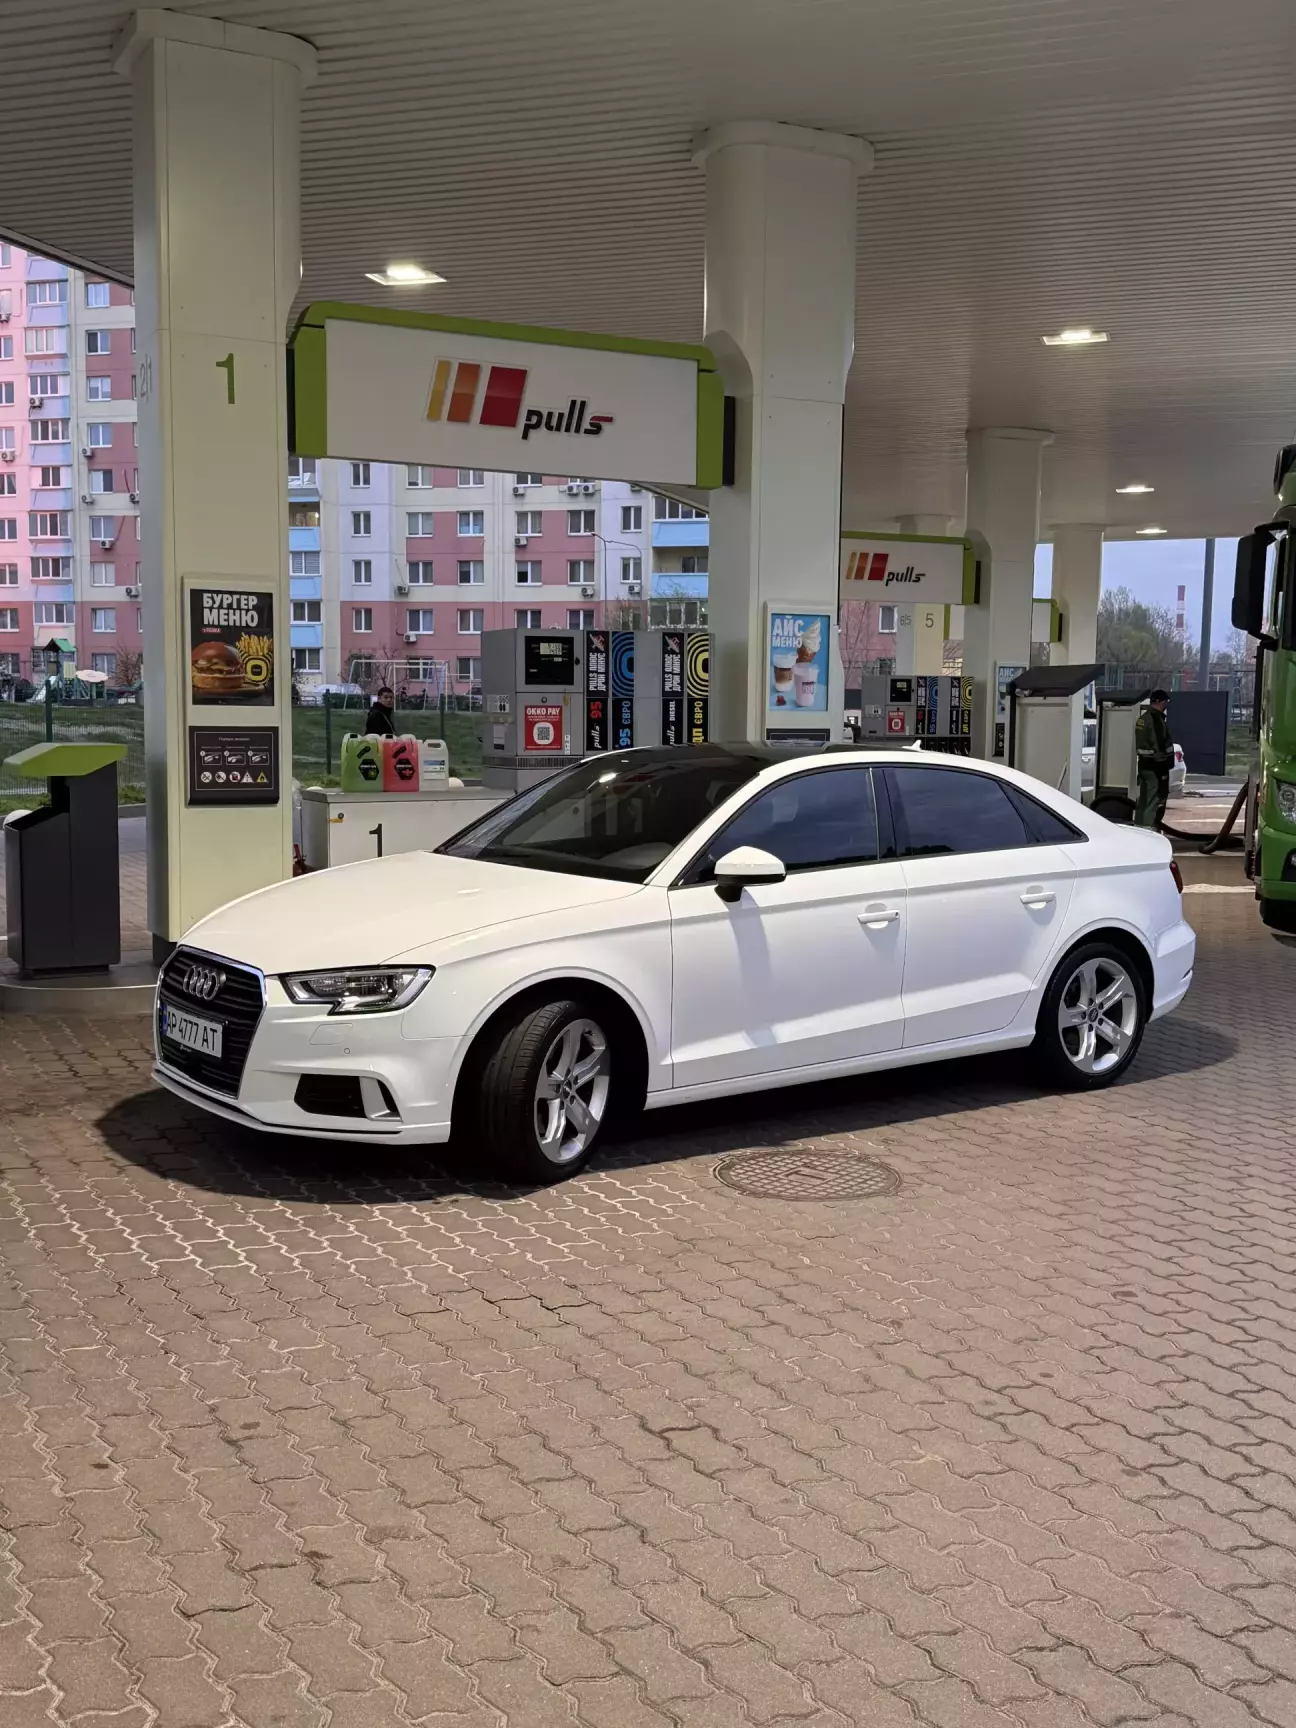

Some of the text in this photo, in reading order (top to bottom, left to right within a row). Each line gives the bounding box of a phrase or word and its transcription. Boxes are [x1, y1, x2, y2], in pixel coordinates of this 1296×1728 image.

[215, 352, 236, 405] 1
[521, 399, 614, 441] pulls
[884, 566, 926, 587] pulls
[202, 592, 258, 609] БУРГЕР
[203, 608, 259, 627] МЕНЮ
[772, 615, 804, 637] АЙС
[924, 612, 934, 629] 5
[772, 636, 803, 648] МЕНЮ
[589, 672, 598, 691] PULLS
[597, 653, 607, 692] ДРОН МІНУС
[664, 673, 673, 692] PULLS
[672, 654, 682, 692] ДРОН МІНУС
[527, 707, 561, 716] OKKO PAY
[590, 701, 602, 749] pulls 95
[620, 701, 631, 746] 95 ЄВРО
[692, 701, 704, 744] ДП ЄВРО
[369, 823, 382, 857] 1
[179, 1017, 199, 1045] 4777
[202, 1025, 218, 1052] AT
